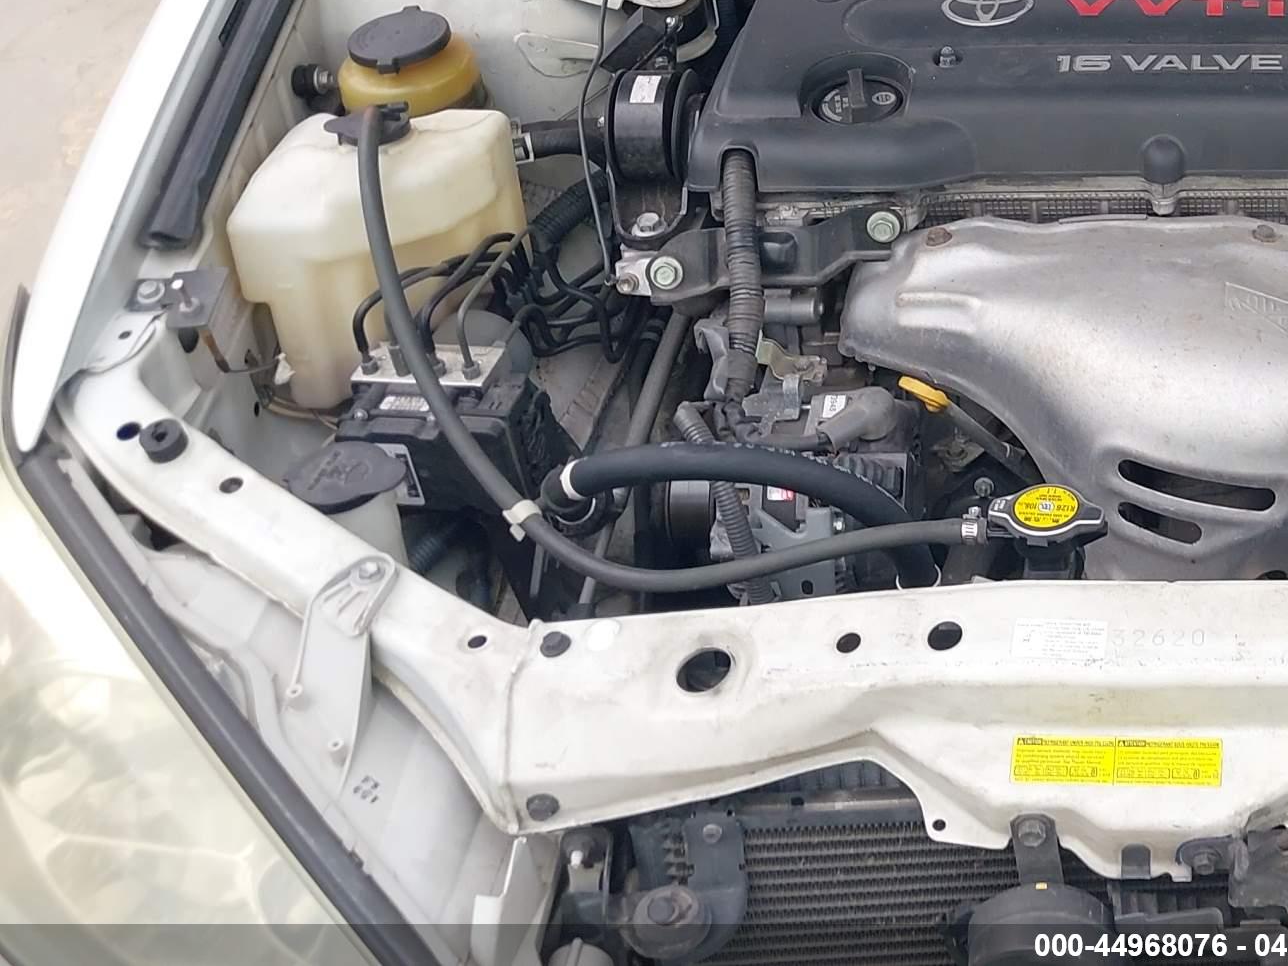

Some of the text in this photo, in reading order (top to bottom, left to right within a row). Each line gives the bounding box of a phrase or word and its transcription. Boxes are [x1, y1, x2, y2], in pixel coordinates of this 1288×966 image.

[1058, 54, 1283, 72] 16 VALVE
[1112, 628, 1205, 647] 32620
